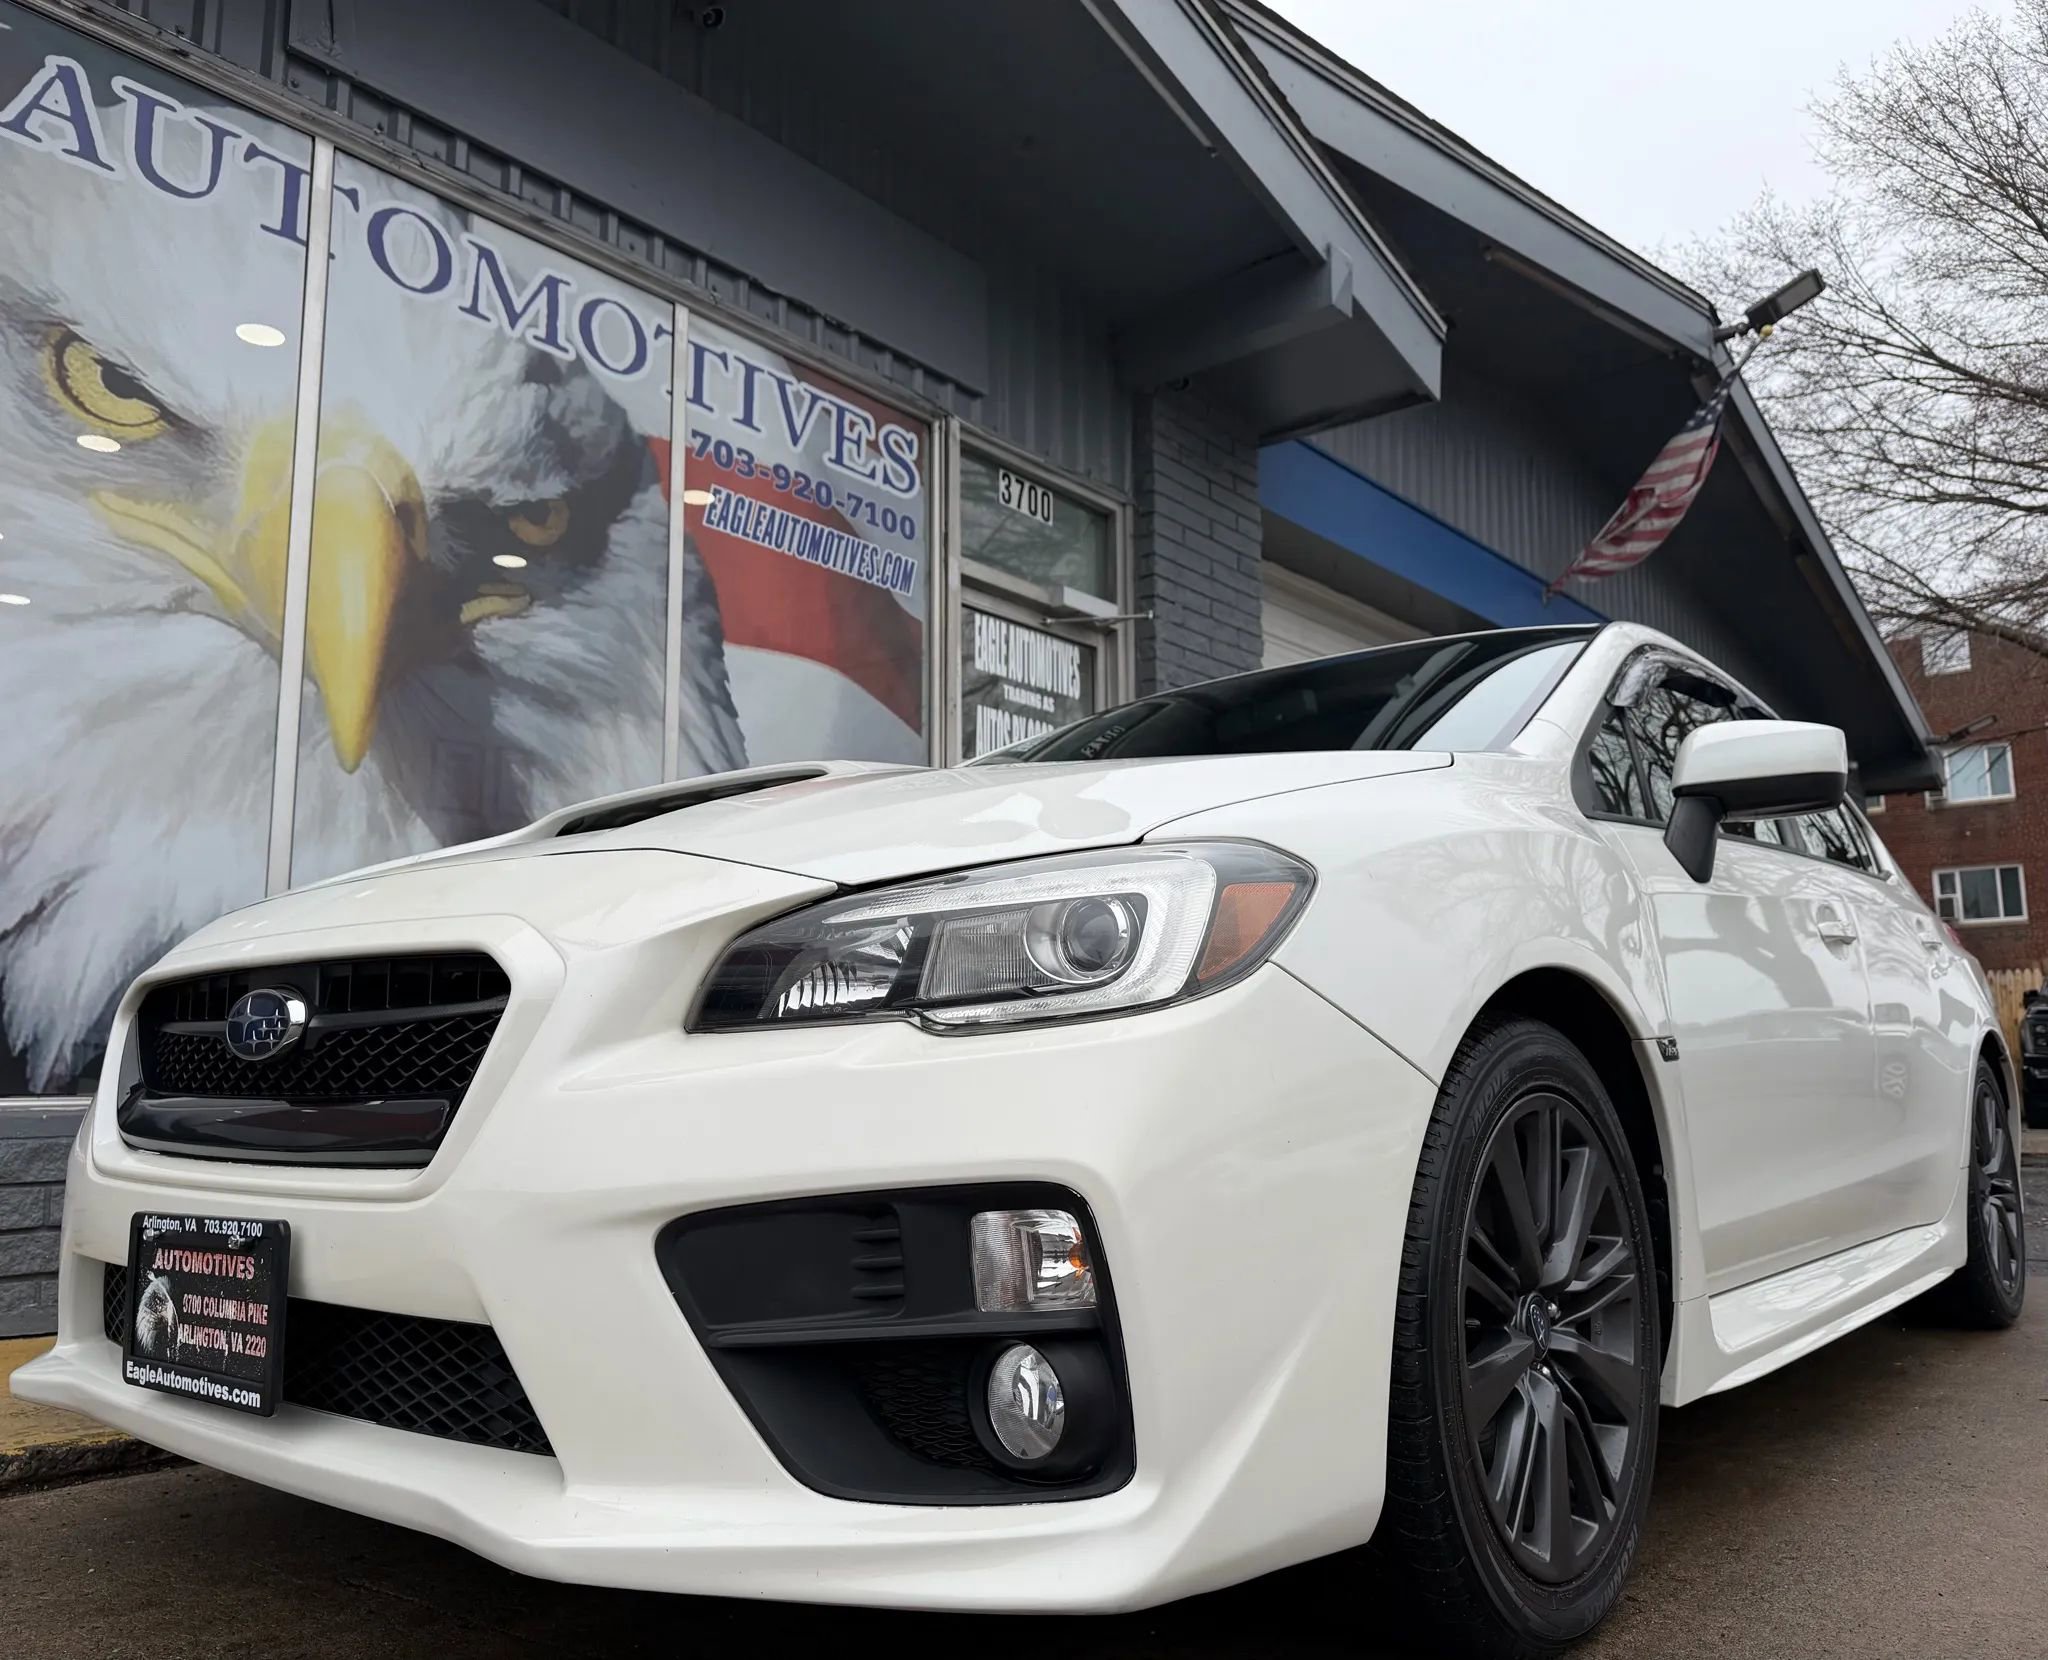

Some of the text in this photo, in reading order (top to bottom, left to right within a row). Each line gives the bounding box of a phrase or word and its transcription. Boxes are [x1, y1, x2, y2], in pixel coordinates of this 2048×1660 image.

[1, 60, 919, 494] AUTOMOTIVES
[690, 428, 916, 541] 703-920-7100
[1002, 472, 1050, 522] 3700
[704, 486, 917, 596] EAGLEAUTOMOTIVES.COM
[974, 612, 1081, 701] EAGLE AUTOMOTIVES
[1003, 684, 1055, 712] TRADING AS
[143, 1215, 263, 1238] Arlington, VA 703.920.7100
[153, 1247, 255, 1280] AUTOMOTIVES
[183, 1293, 269, 1326] 3700 COLUMBIA PIKE
[231, 1331, 243, 1354] VA
[126, 1360, 261, 1408] EagleAutomotives.com
